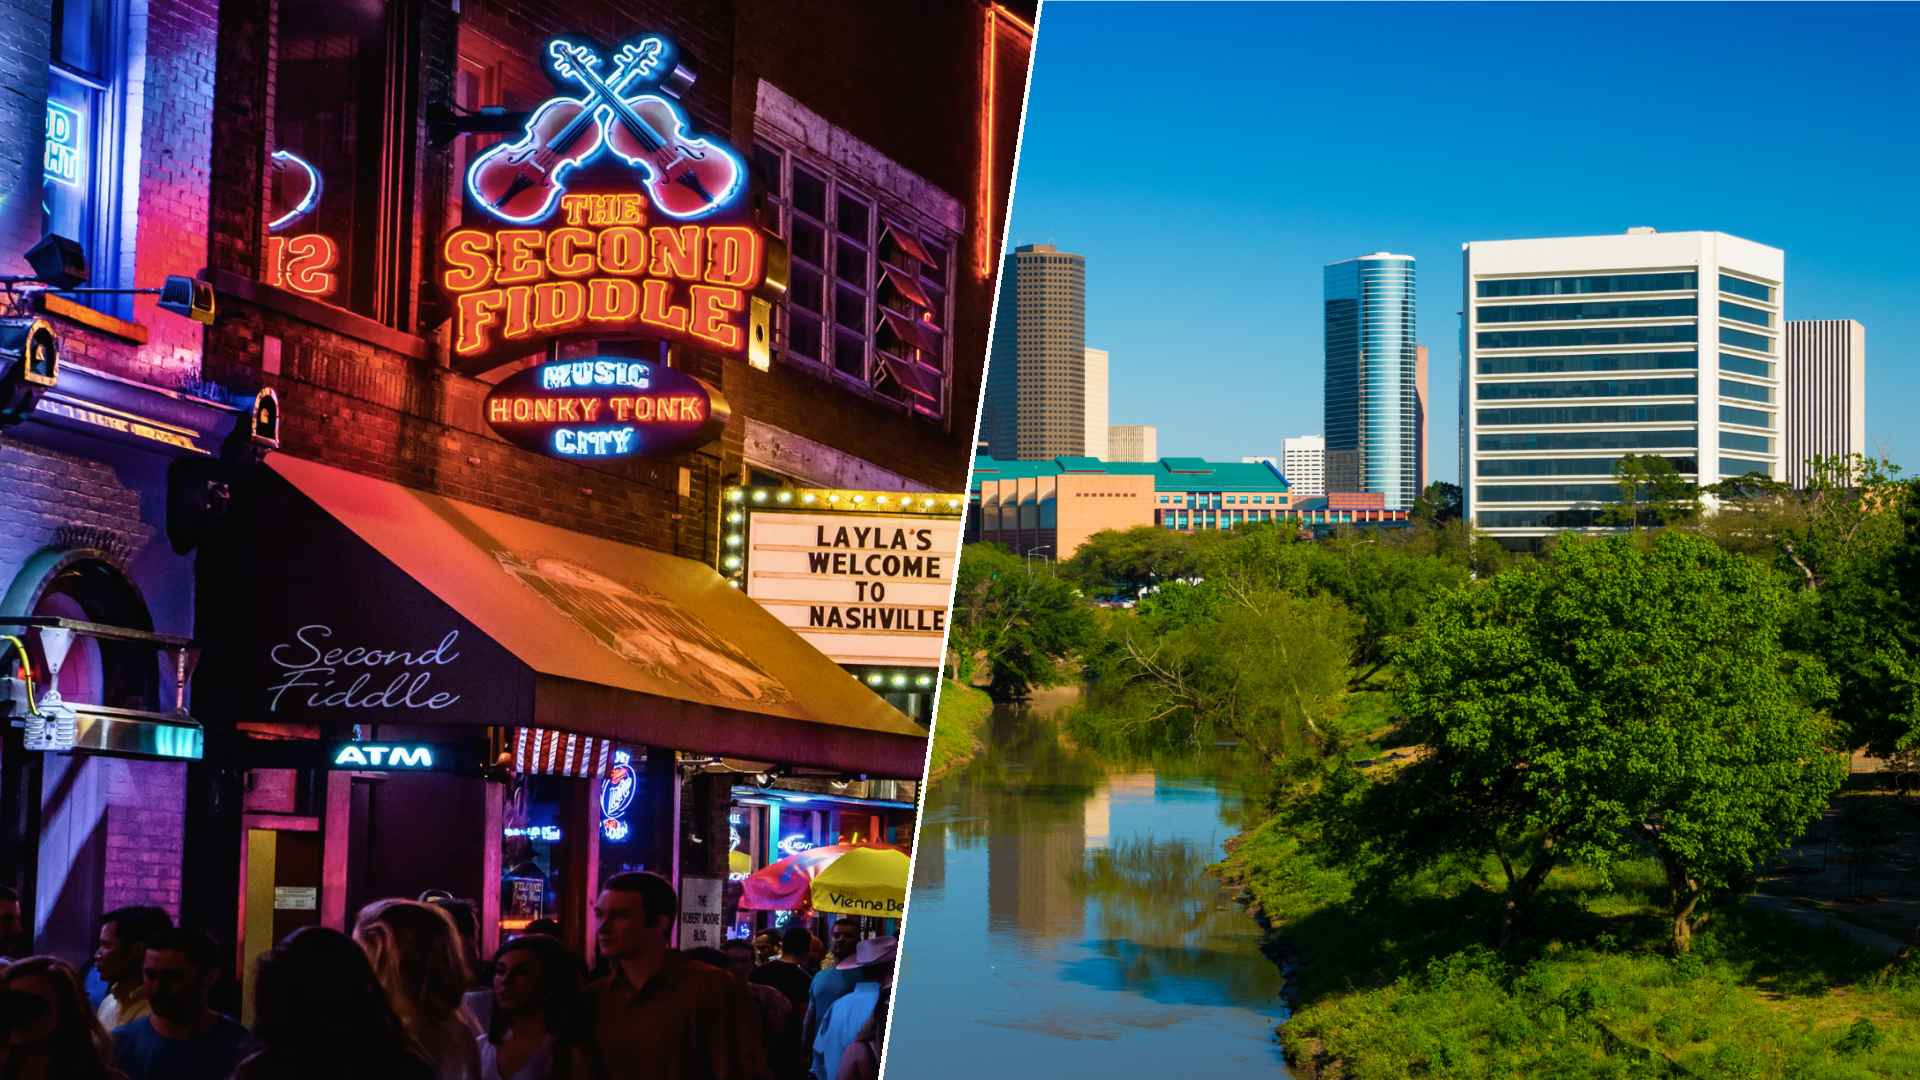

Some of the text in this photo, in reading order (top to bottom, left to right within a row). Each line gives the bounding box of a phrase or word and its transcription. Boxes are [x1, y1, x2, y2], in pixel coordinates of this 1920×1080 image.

[562, 193, 643, 225] THE
[445, 225, 760, 291] SECOND
[456, 279, 742, 353] FIDDLE
[543, 361, 650, 389] MUSIC
[490, 397, 702, 422] HONKY TONK
[555, 428, 634, 455] CITY
[816, 525, 933, 550] LAYLA'S
[808, 552, 941, 578] WELCOME
[856, 581, 885, 602] TO
[809, 605, 945, 631] NASHVILLE
[271, 624, 460, 668] Second
[267, 668, 460, 711] Fiddle
[335, 746, 432, 766] ATM
[830, 893, 883, 911] Vienna
